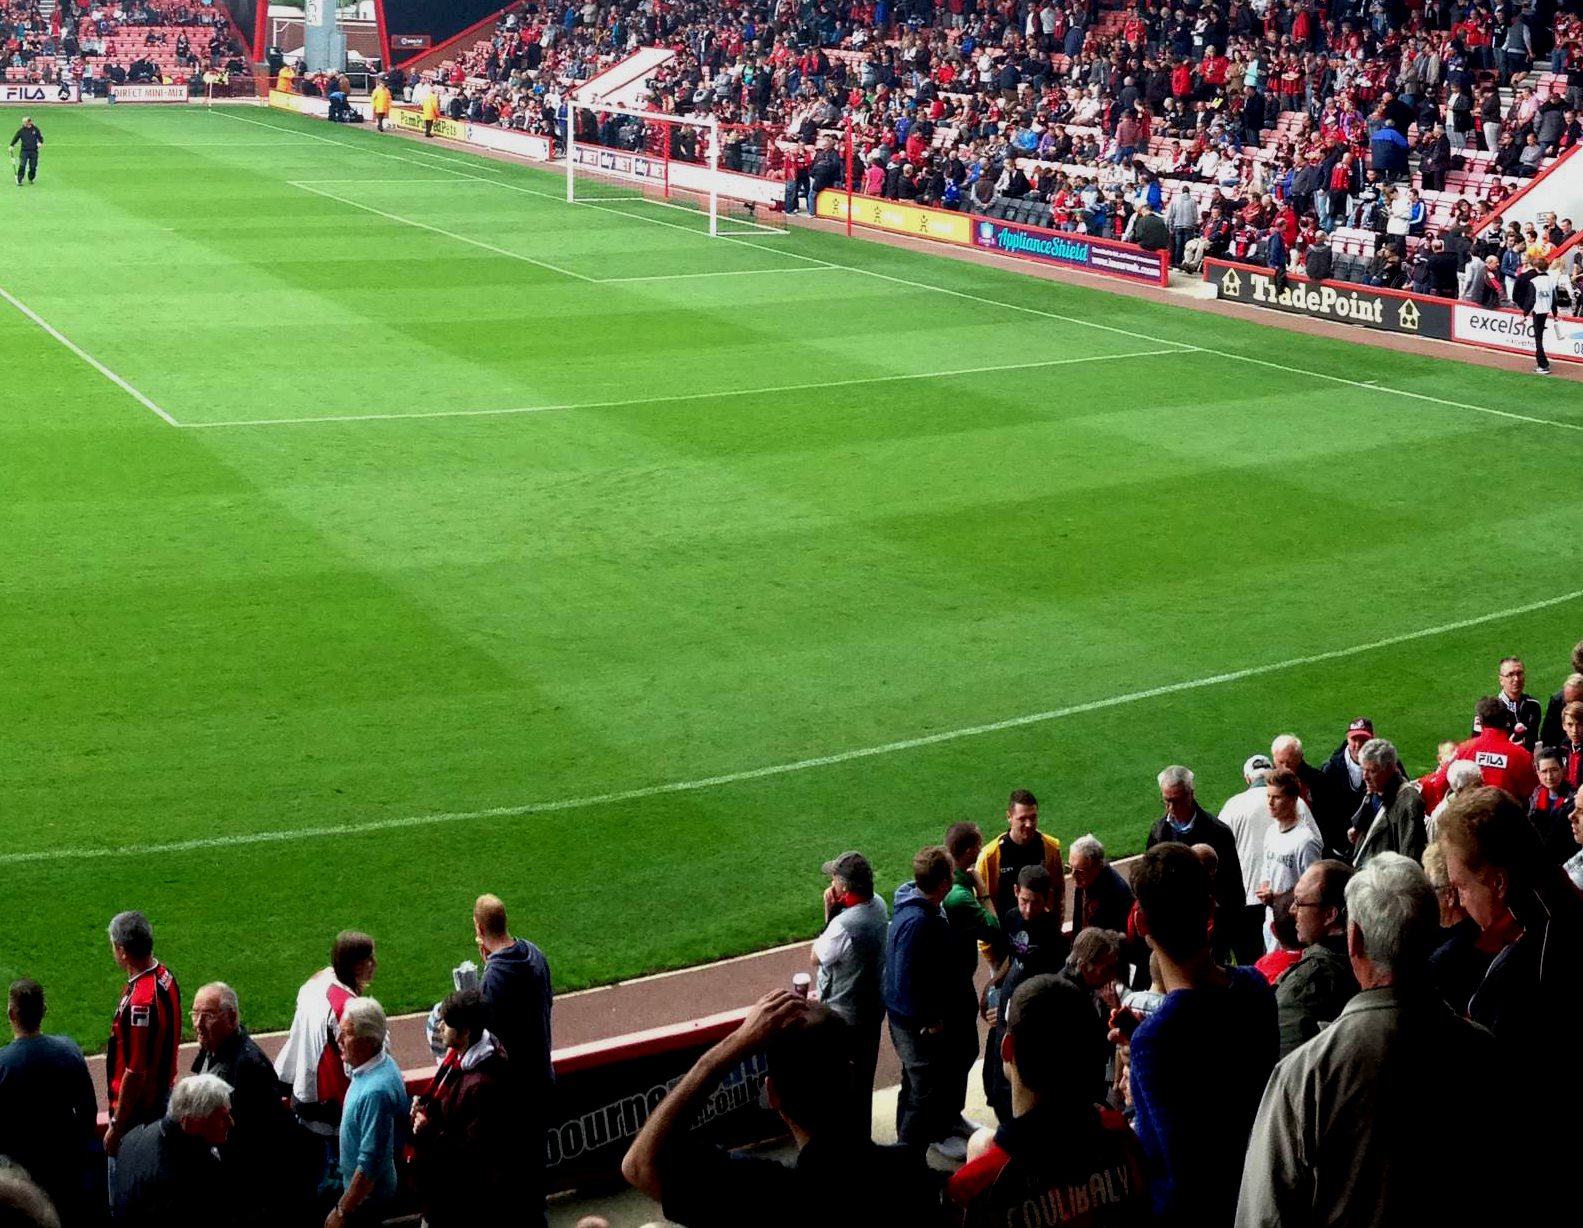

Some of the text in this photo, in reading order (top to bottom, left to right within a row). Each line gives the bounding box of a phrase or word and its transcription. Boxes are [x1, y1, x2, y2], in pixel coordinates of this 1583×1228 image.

[6, 87, 46, 100] FILA
[114, 87, 184, 98] DIRECT MINI-MIX
[998, 227, 1088, 262] ApplianceShield
[1251, 273, 1383, 323] TradePoint
[1478, 754, 1504, 767] FILA
